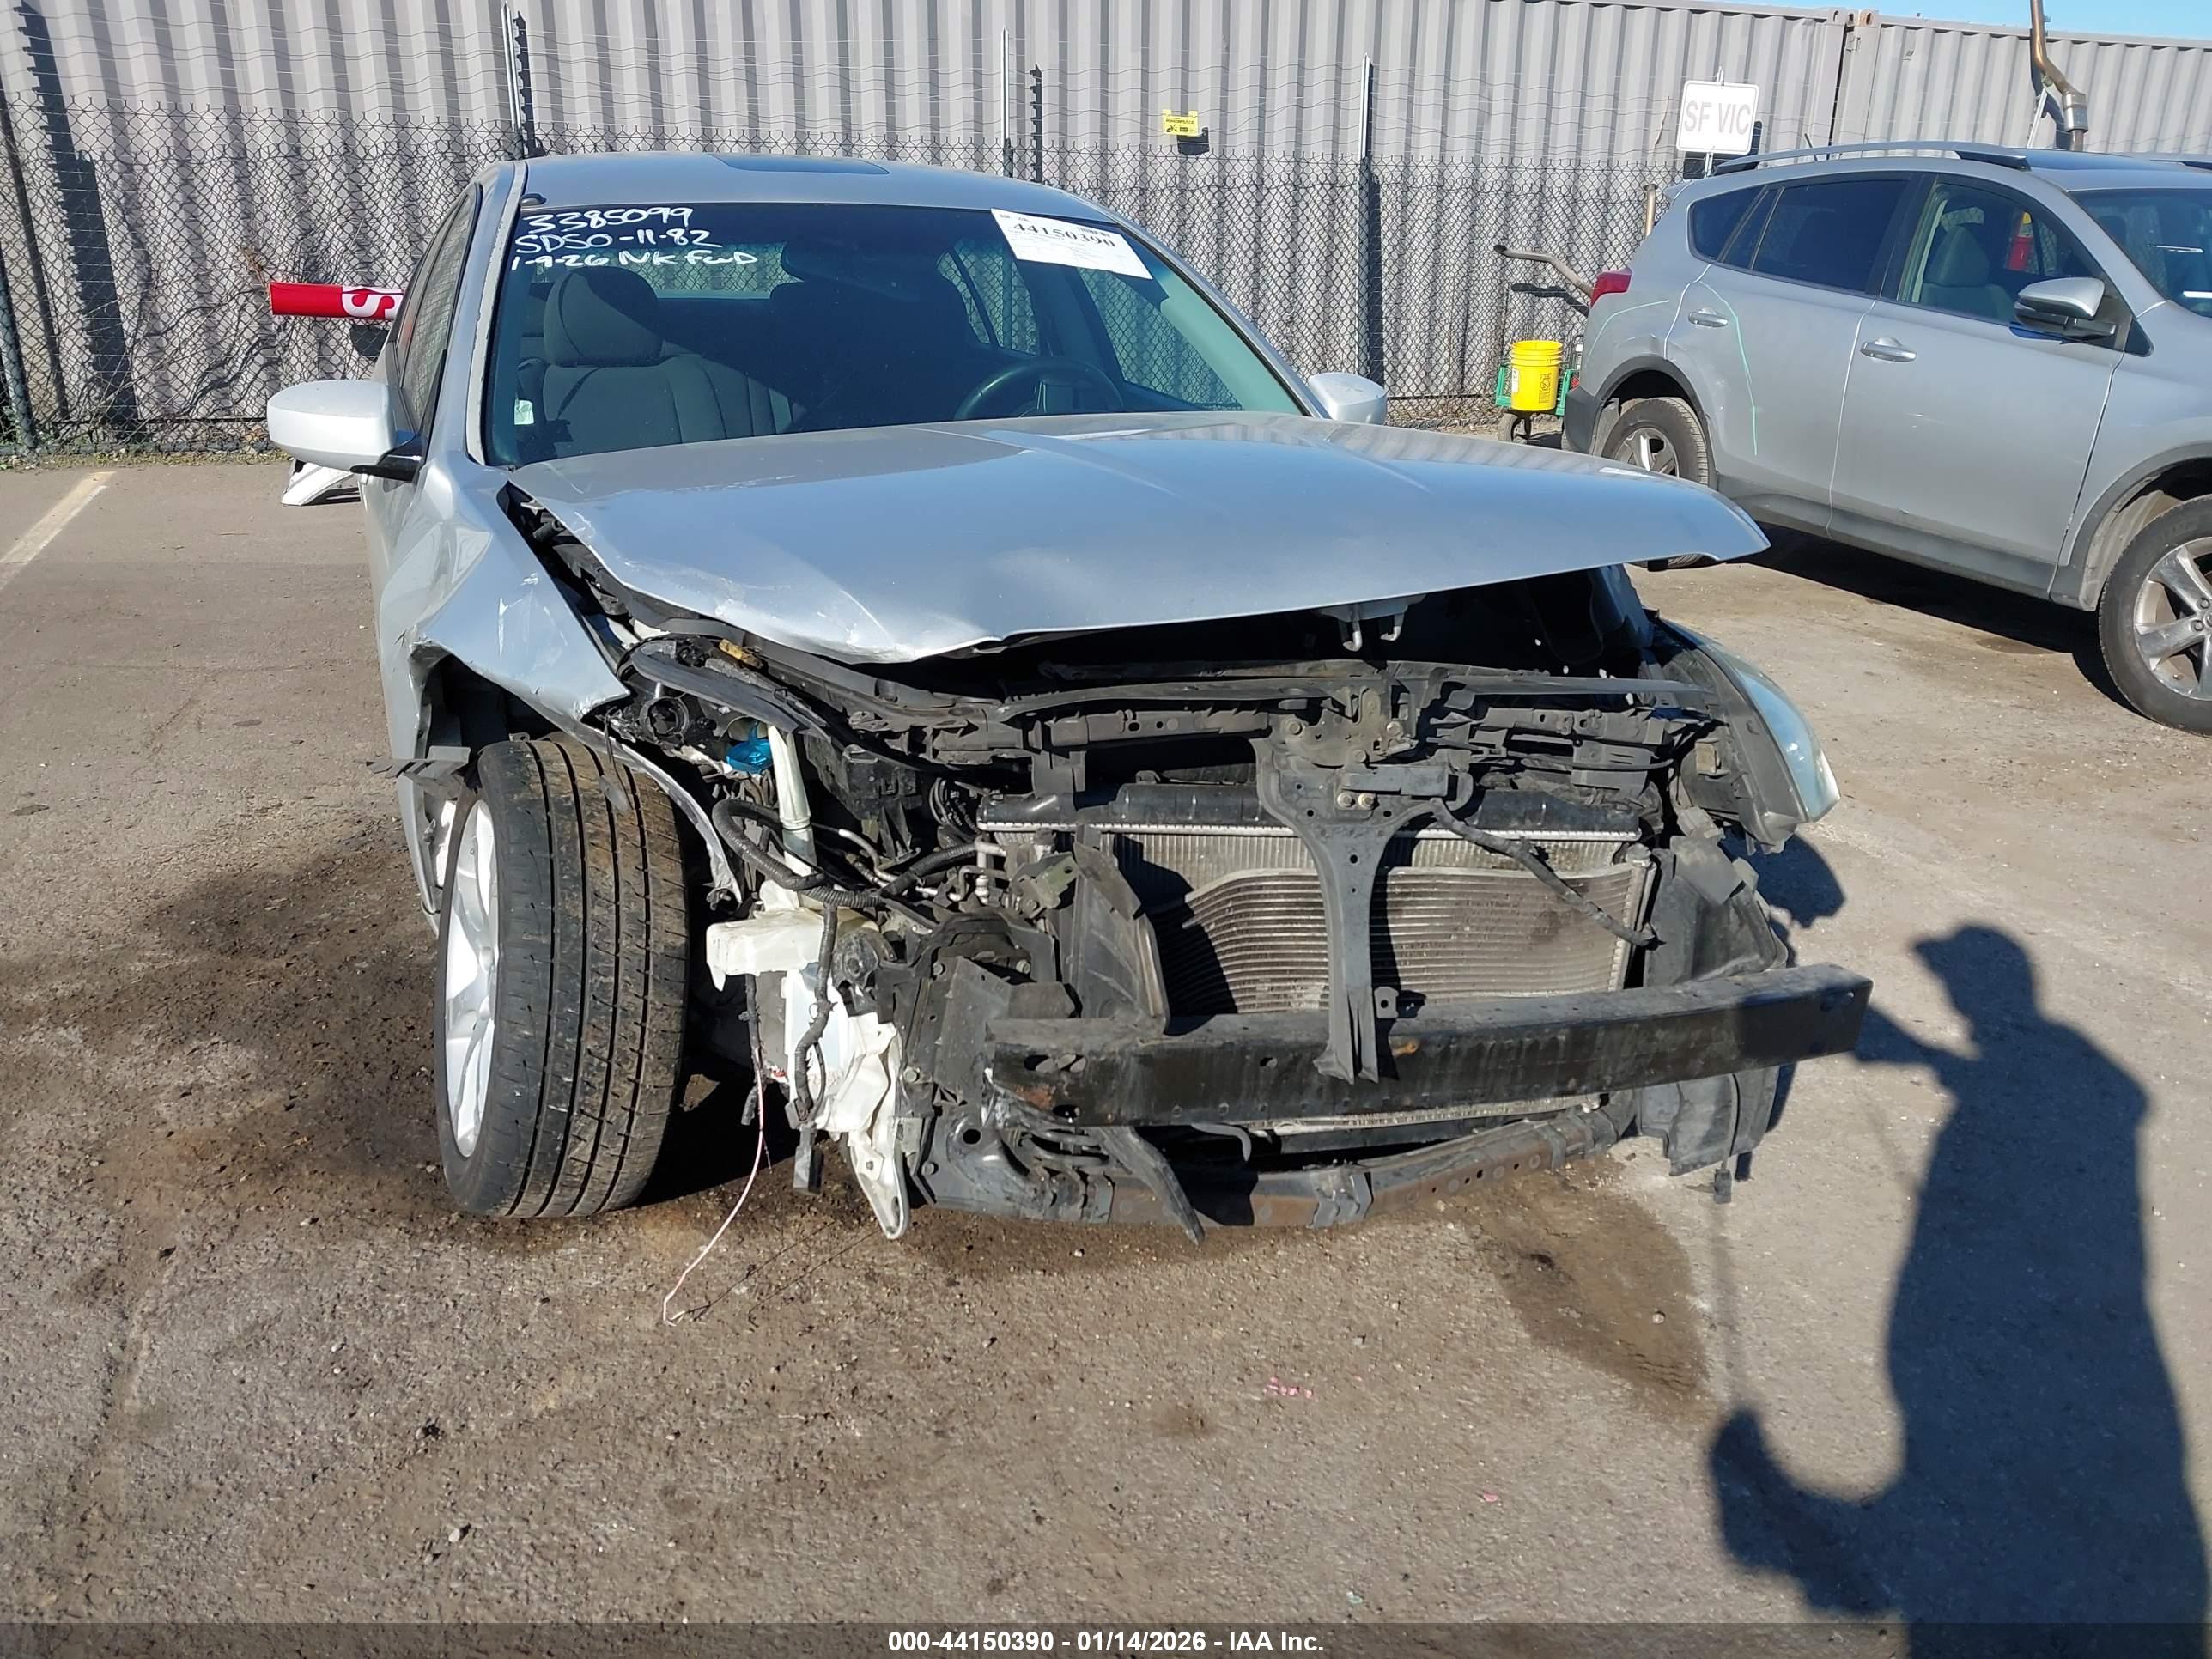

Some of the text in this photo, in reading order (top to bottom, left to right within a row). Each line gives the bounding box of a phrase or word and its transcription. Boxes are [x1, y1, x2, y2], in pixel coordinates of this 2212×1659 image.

[1684, 100, 1751, 135] SF VIC
[522, 207, 694, 234] 3385099
[1013, 222, 1116, 248] 44150390
[511, 254, 609, 270] 1-9-26
